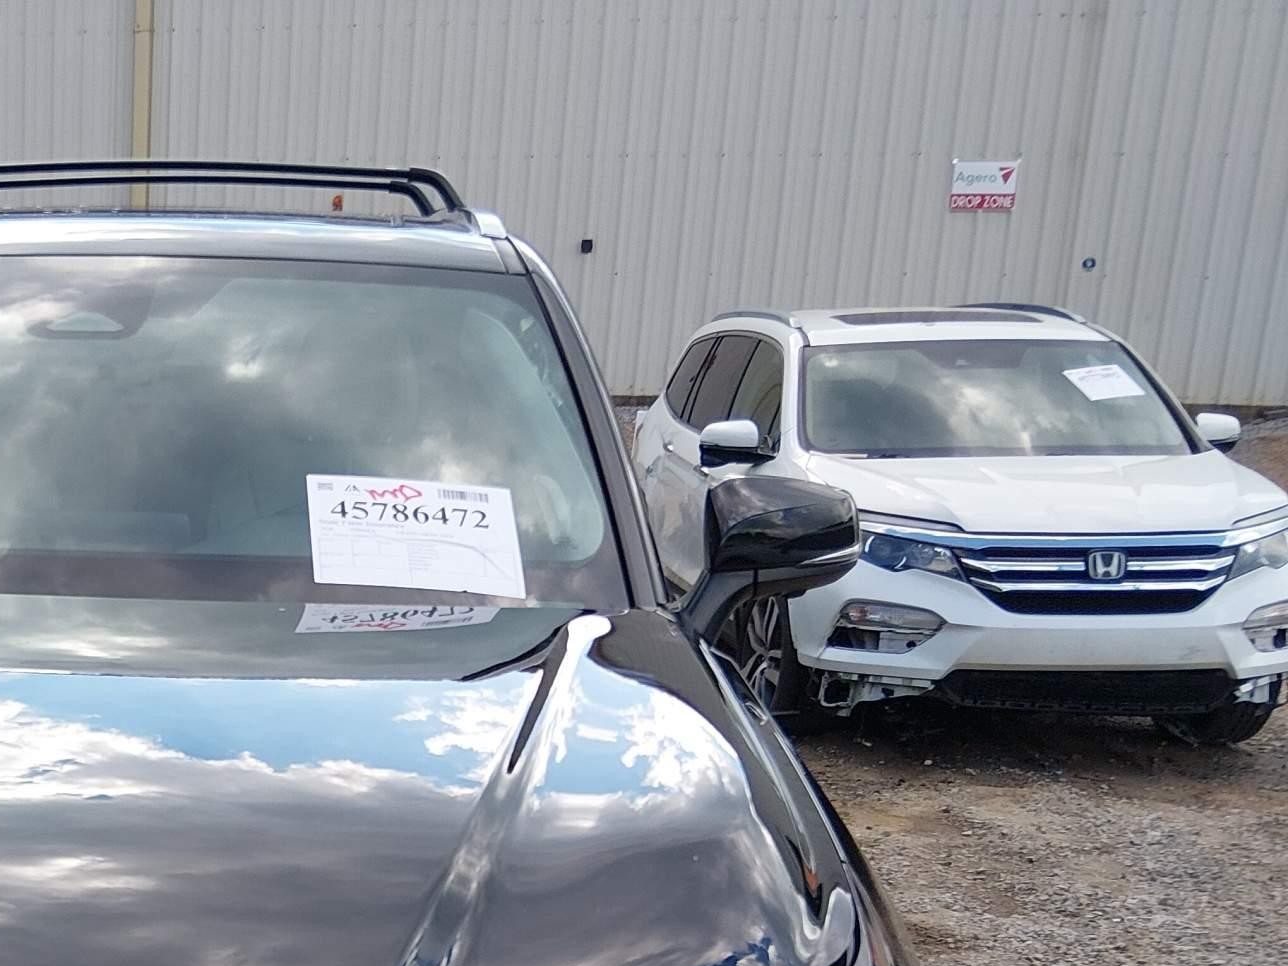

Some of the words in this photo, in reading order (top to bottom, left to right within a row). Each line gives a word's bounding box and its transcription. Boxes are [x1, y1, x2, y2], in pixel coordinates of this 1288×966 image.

[955, 171, 998, 185] Agero
[951, 195, 982, 208] DROP
[983, 195, 1014, 208] ZONE
[330, 500, 489, 529] 45786472
